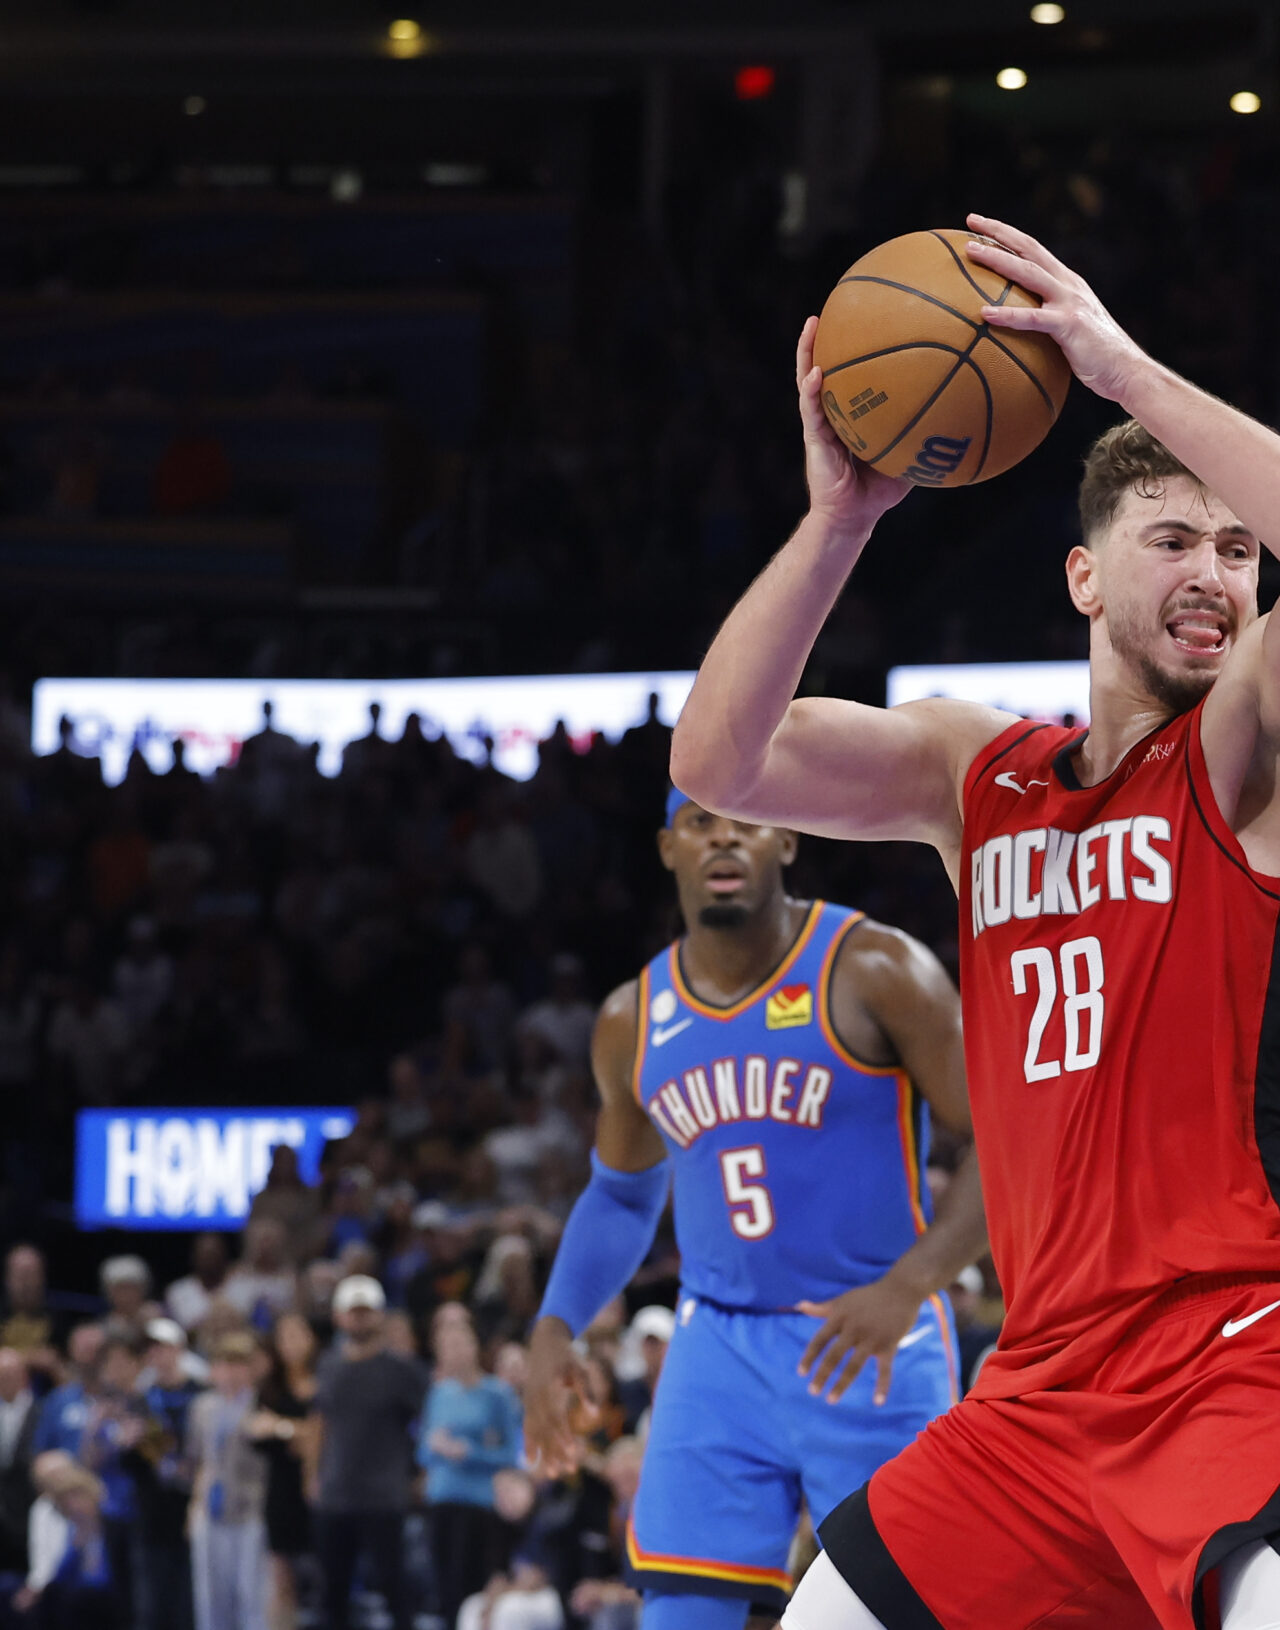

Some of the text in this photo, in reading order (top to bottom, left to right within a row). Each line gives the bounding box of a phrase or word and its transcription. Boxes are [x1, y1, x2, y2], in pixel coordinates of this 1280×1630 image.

[971, 815, 1173, 940] ROCKETS
[1010, 935, 1105, 1084] 28
[649, 1054, 834, 1150] THUNDER
[718, 1144, 776, 1241] 5
